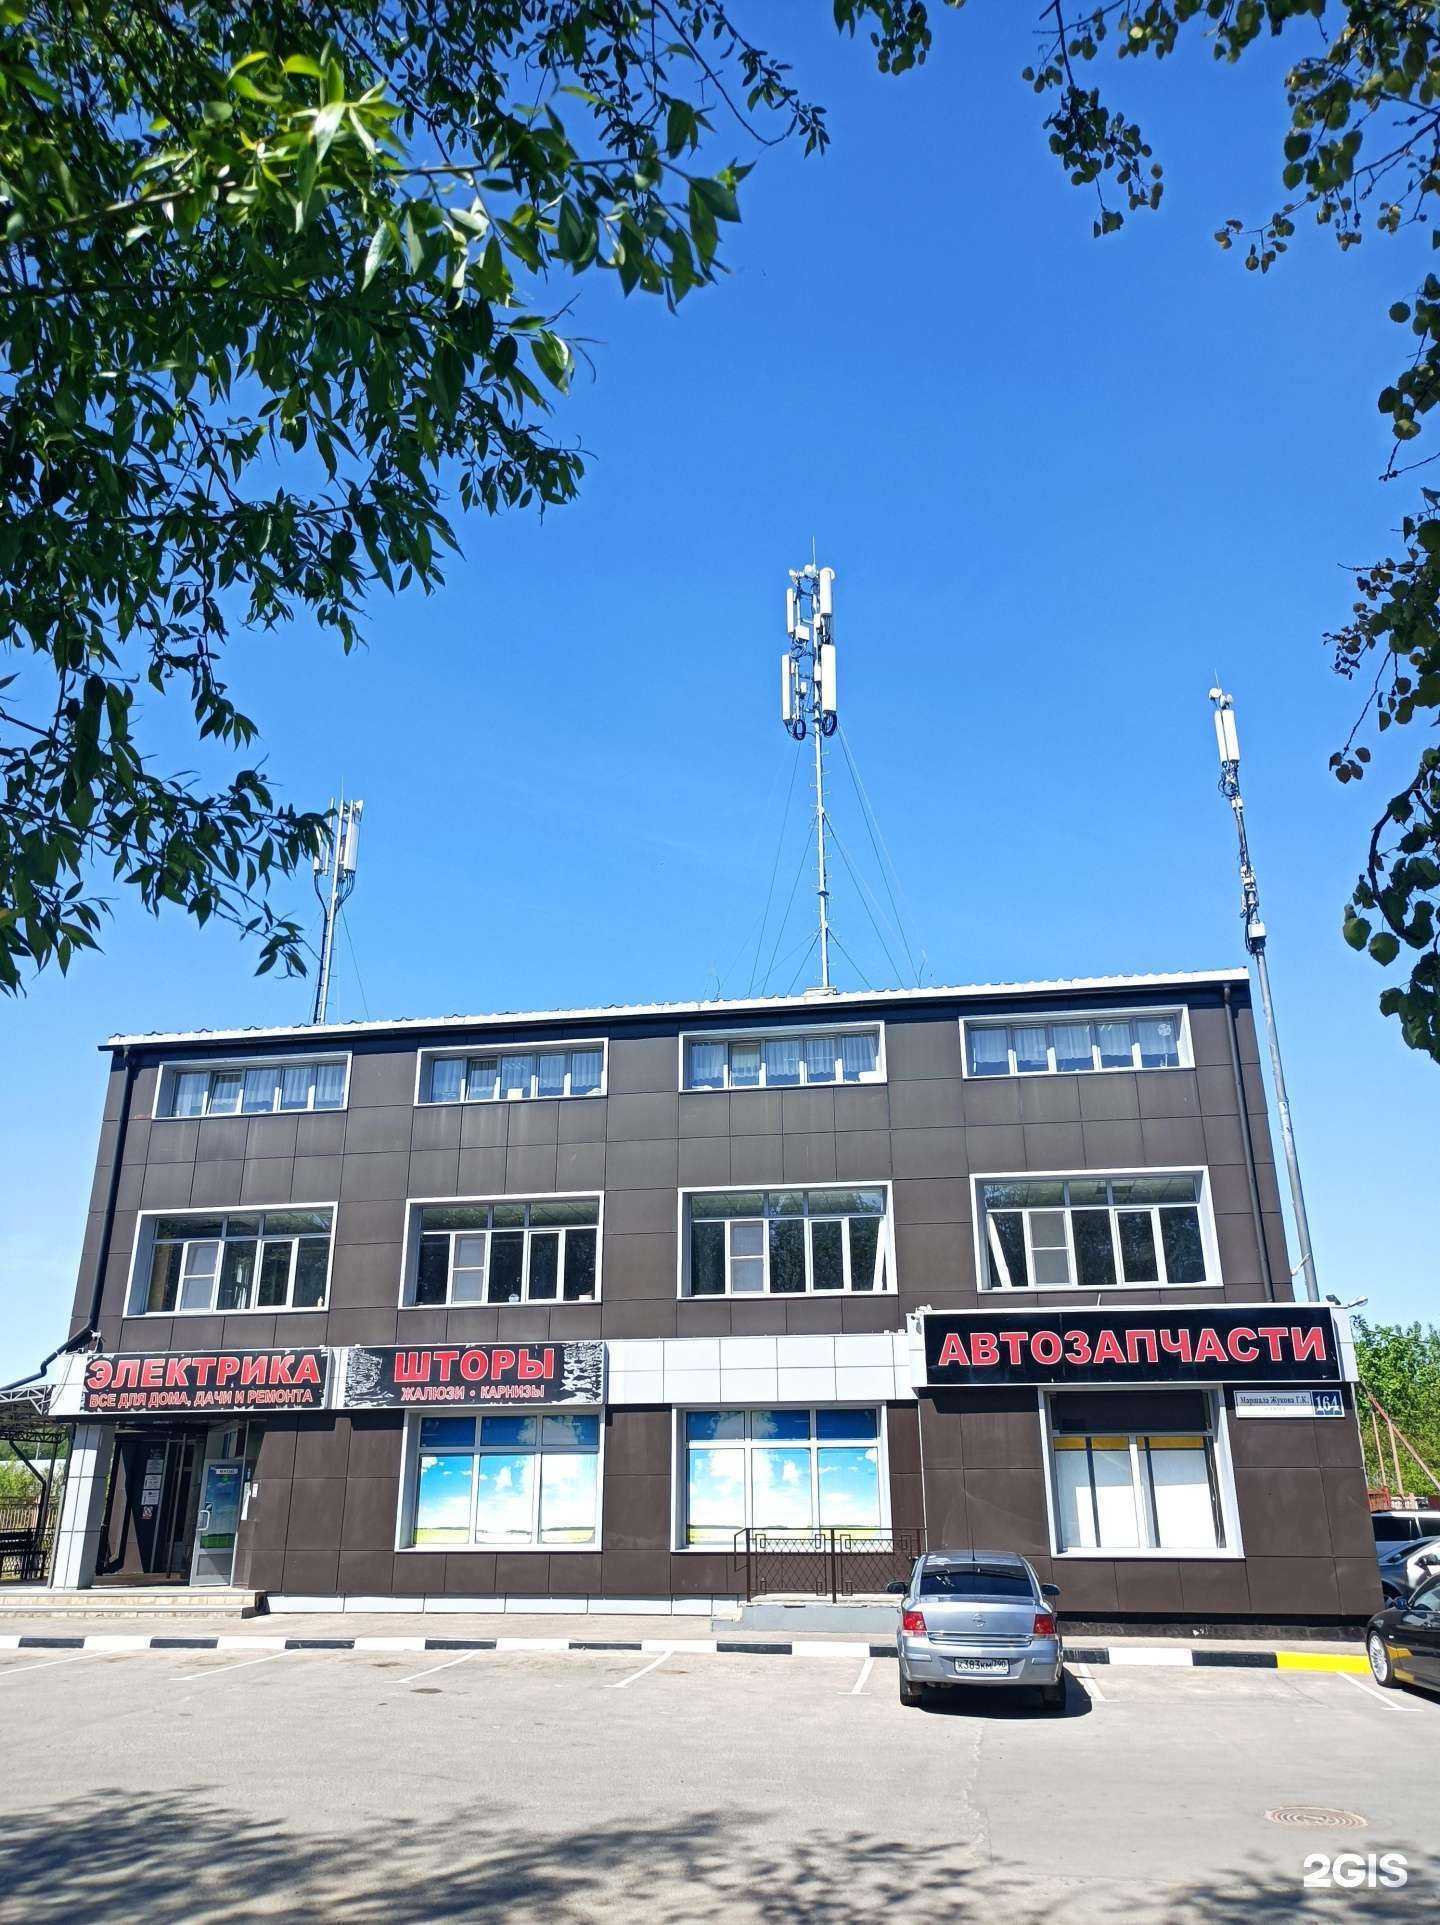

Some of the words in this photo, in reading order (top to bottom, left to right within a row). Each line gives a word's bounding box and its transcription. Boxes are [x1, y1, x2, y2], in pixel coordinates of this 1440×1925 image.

[938, 1327, 1326, 1366] АВТОЗАПЧАСТИ
[87, 1354, 321, 1390] ЭЛЕКТРИКА
[394, 1348, 555, 1382] ШТОРЫ
[89, 1393, 116, 1408] ВСЕ
[118, 1392, 146, 1409] ДЛЯ
[149, 1391, 191, 1408] ДОМА,
[194, 1390, 234, 1407] ДАЧИ
[235, 1390, 245, 1404] И
[247, 1389, 313, 1404] РЕМОНТА
[401, 1386, 465, 1401] ЖАЛЮЗИ
[480, 1384, 545, 1399] КАРНИЗЫ
[1240, 1396, 1269, 1406] Маршала
[1269, 1395, 1295, 1406] Жукова
[1315, 1395, 1340, 1412] 164
